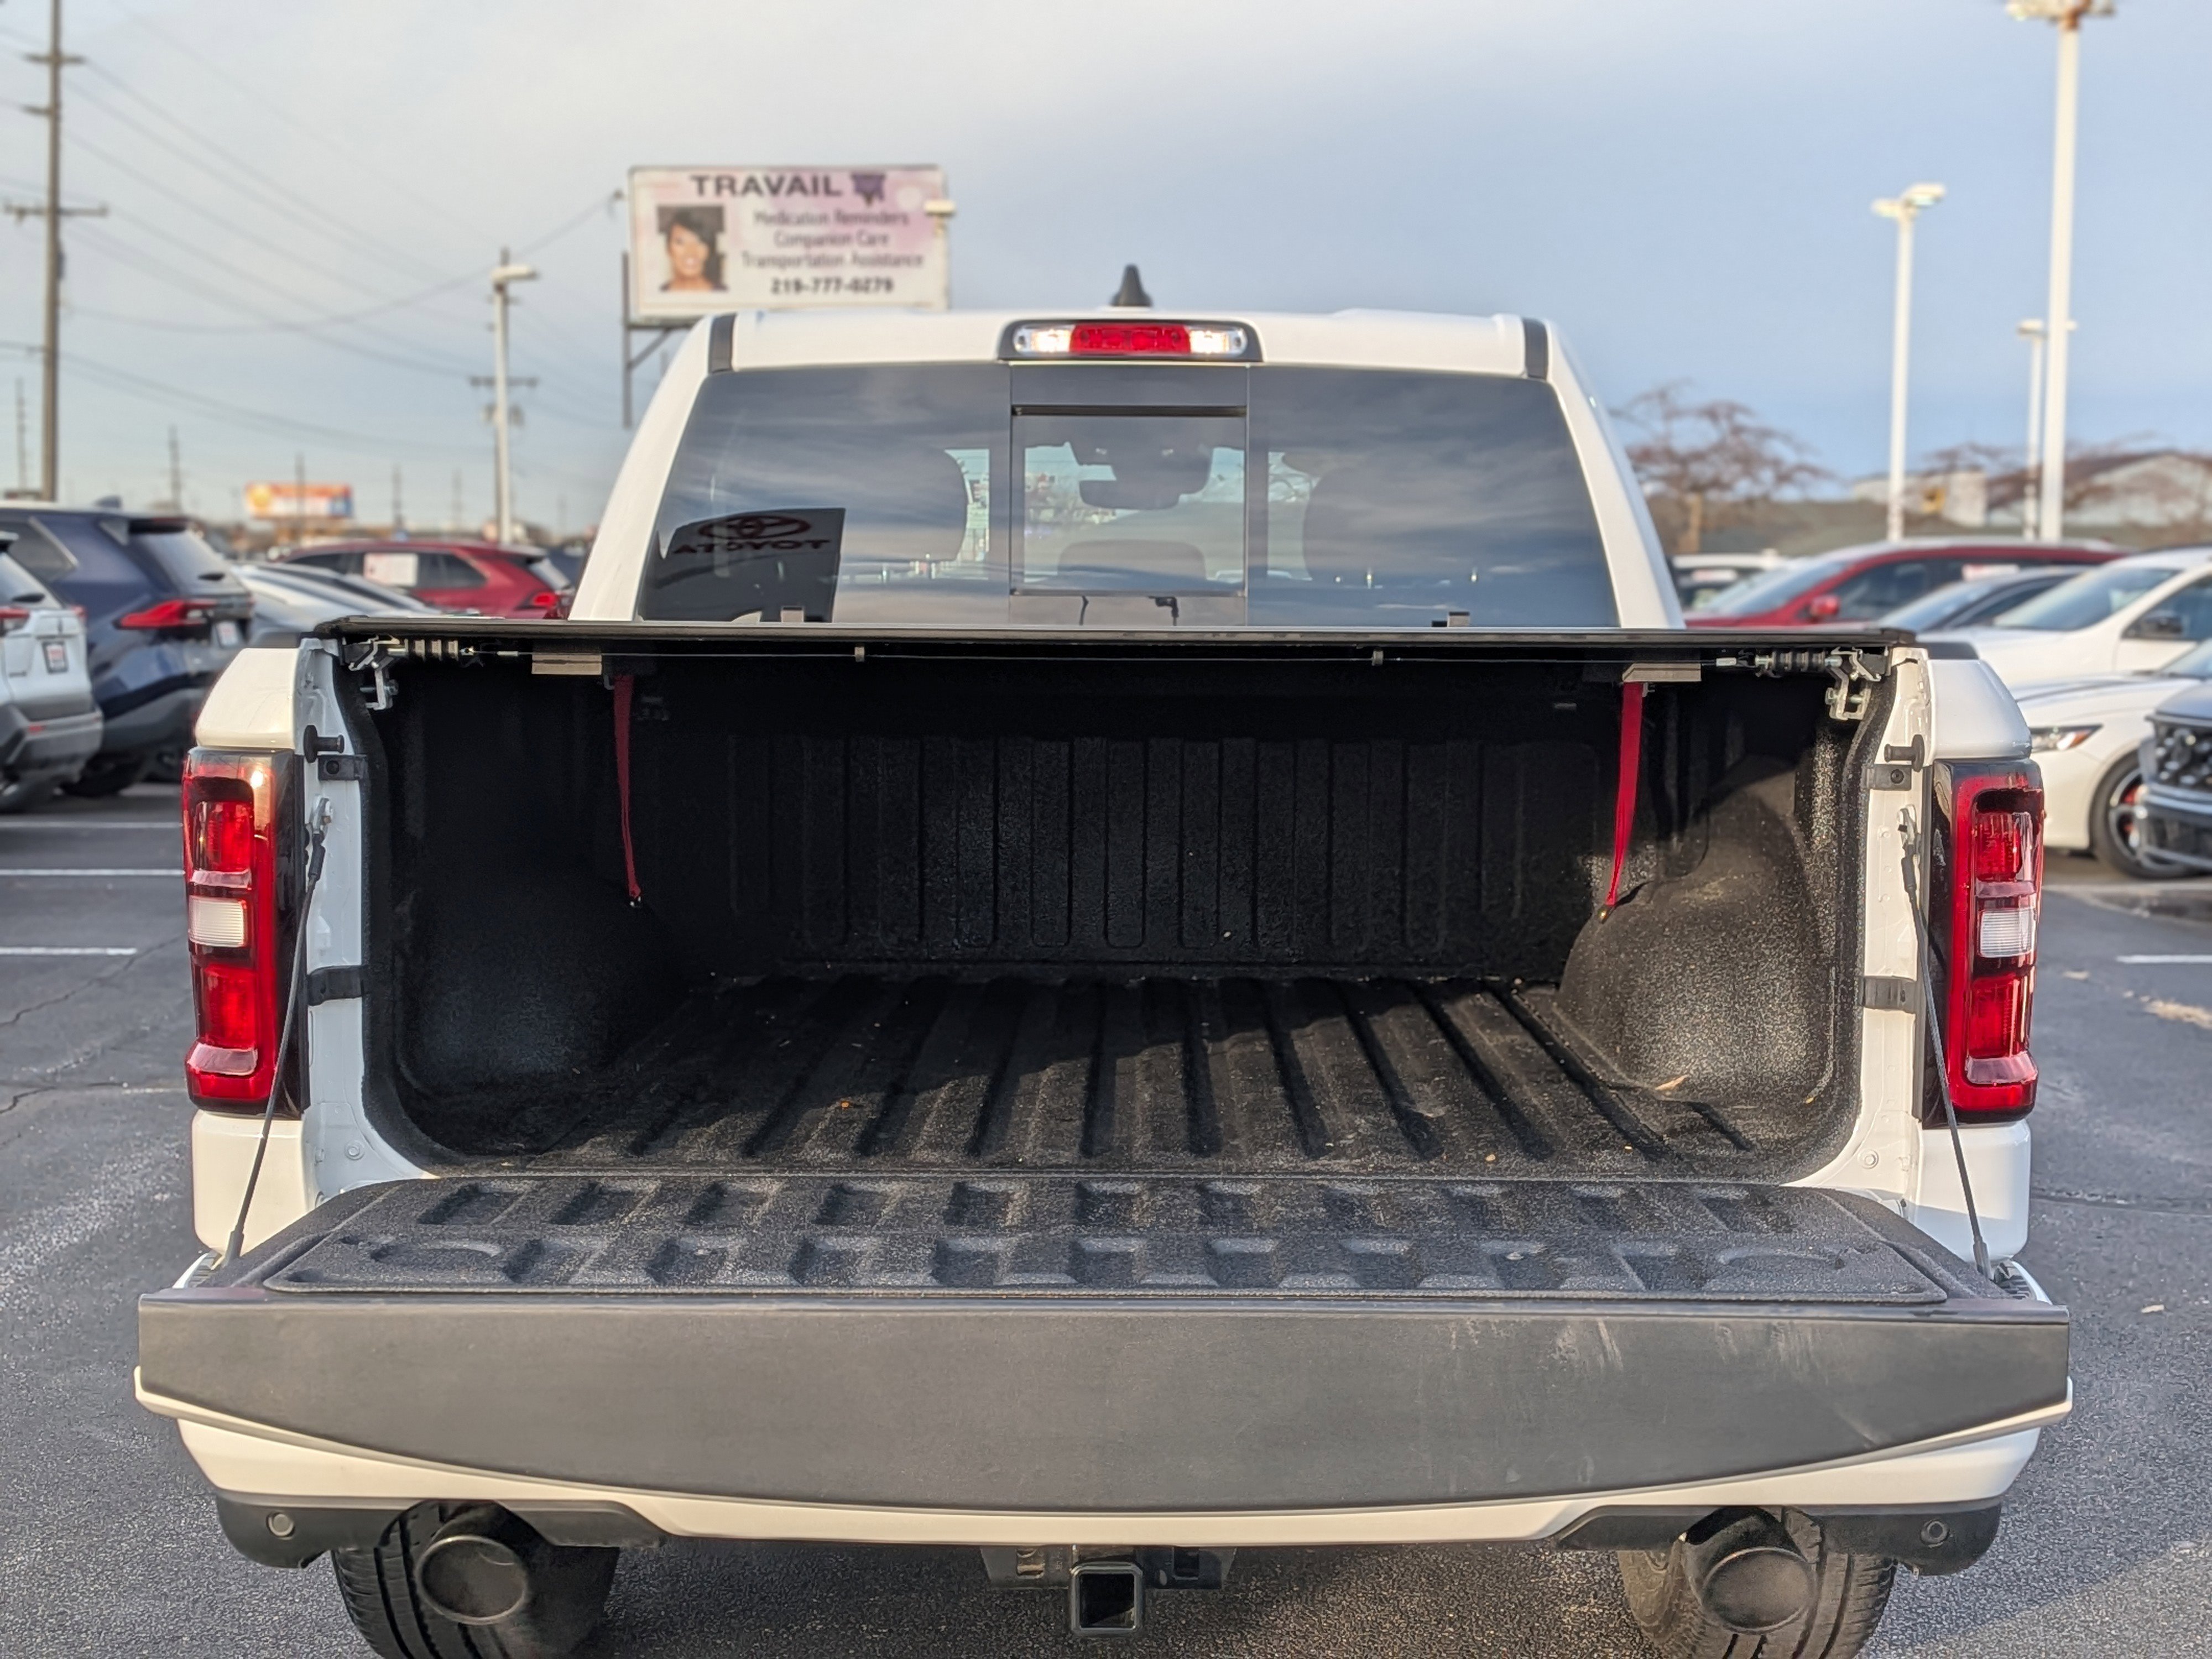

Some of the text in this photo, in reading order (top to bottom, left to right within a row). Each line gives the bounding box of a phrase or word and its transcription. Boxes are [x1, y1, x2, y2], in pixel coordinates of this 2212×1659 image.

[691, 175, 843, 196] TRAVAIL
[754, 209, 909, 226] Medication Reminders
[775, 230, 889, 249] Companion Care
[743, 252, 924, 270] Transportation Assistance
